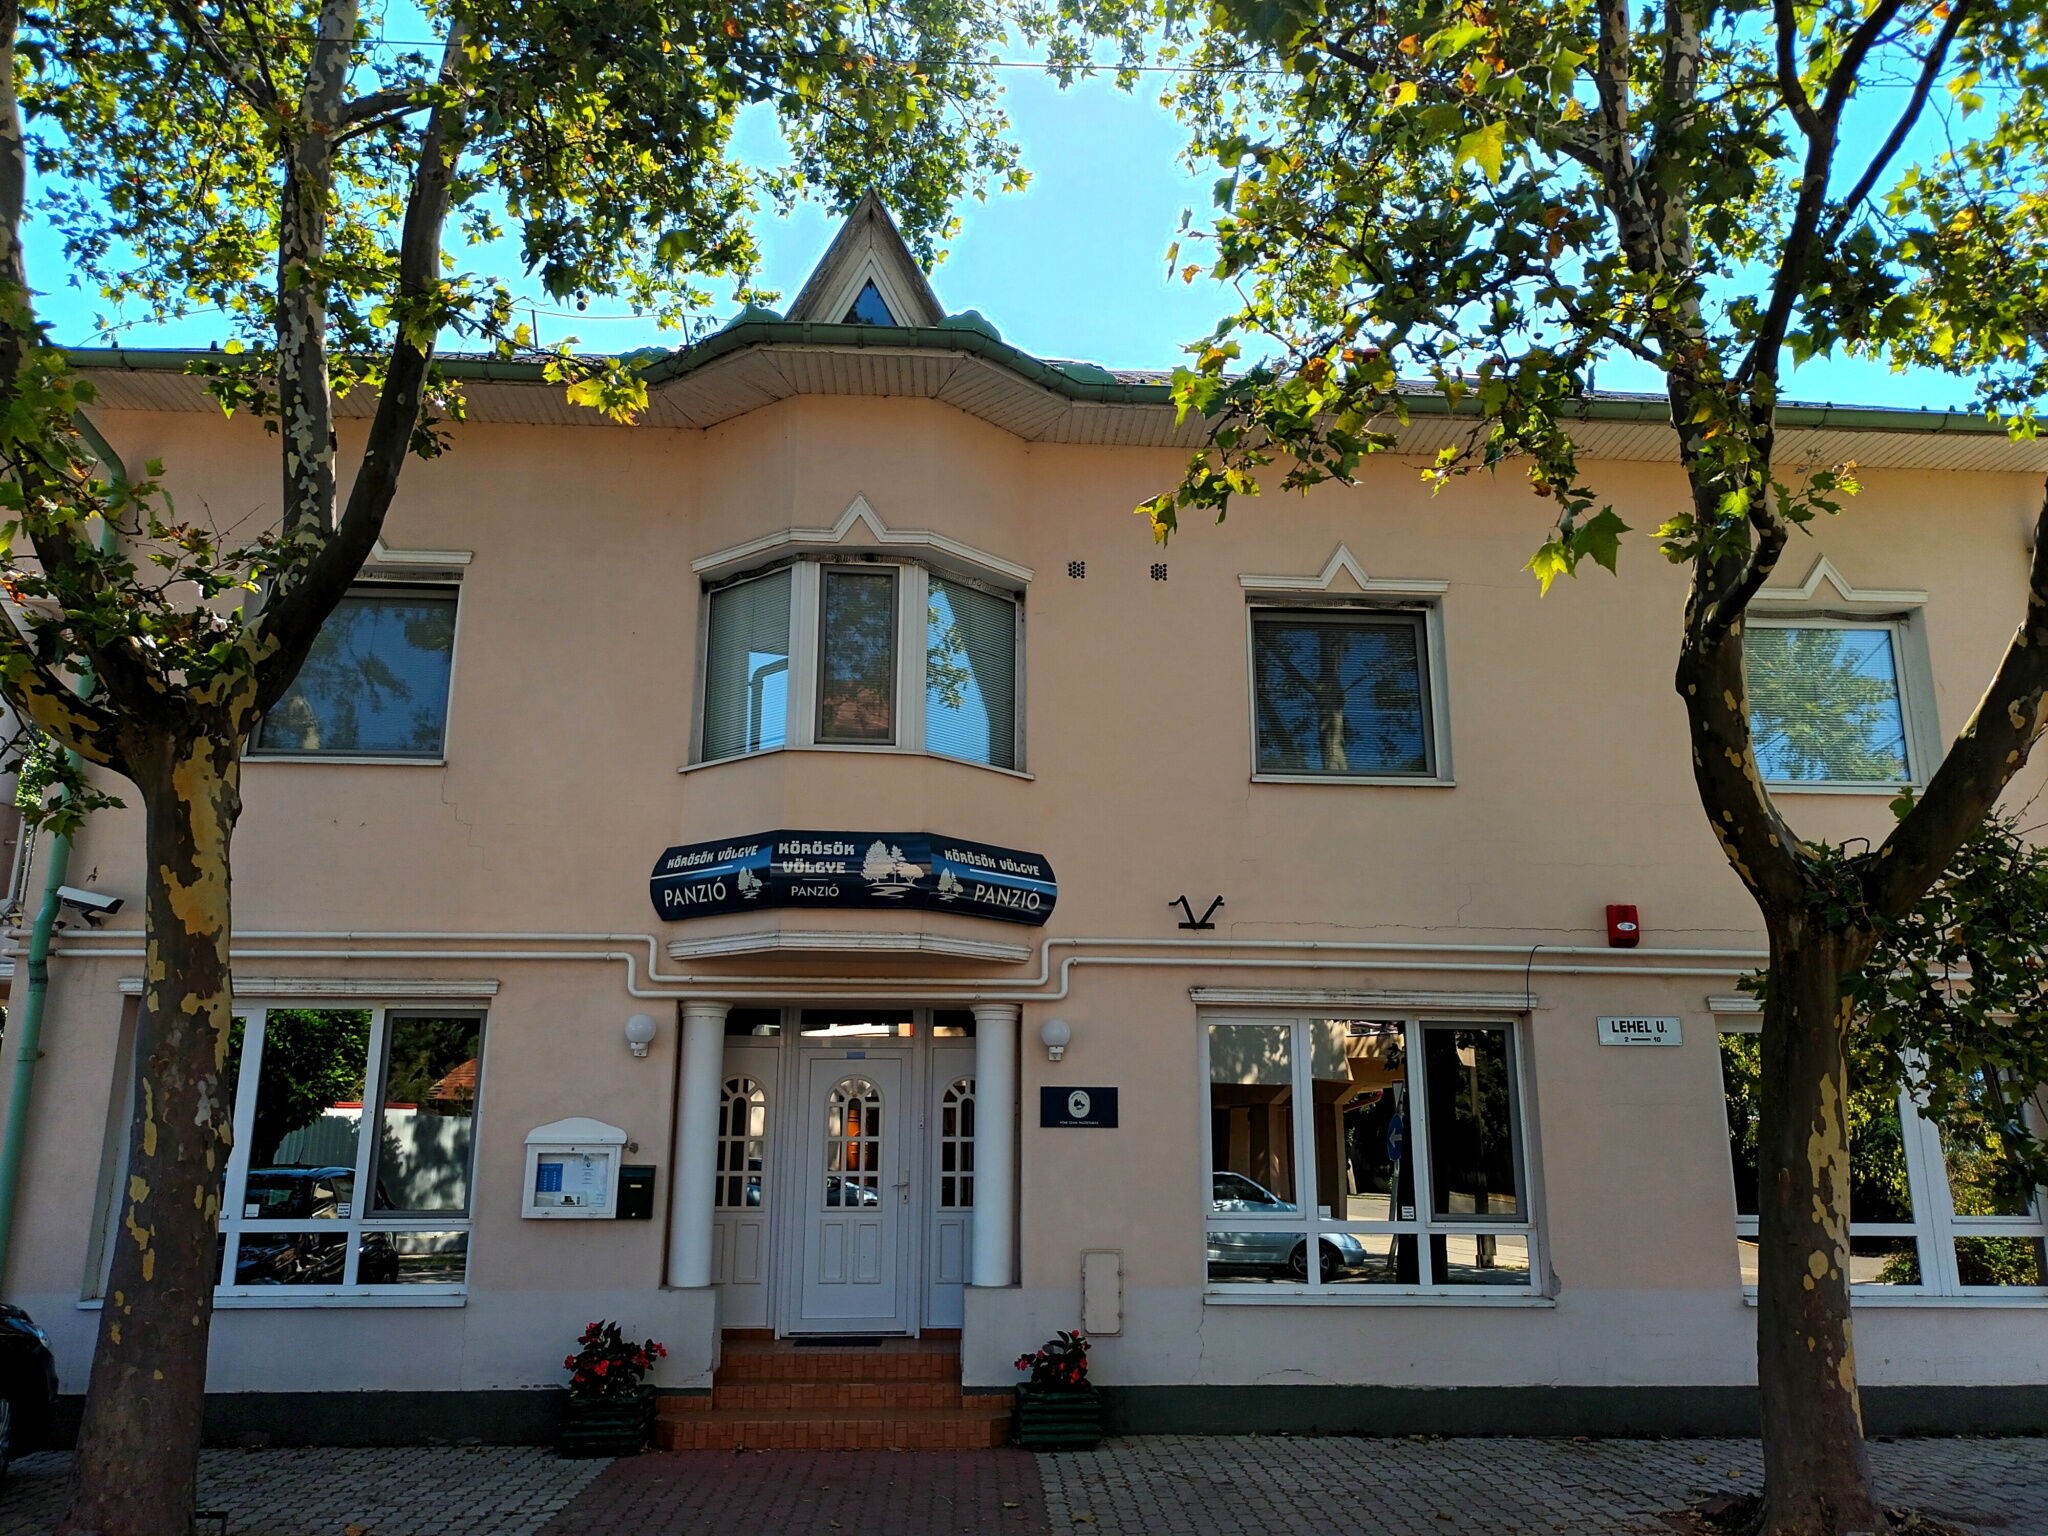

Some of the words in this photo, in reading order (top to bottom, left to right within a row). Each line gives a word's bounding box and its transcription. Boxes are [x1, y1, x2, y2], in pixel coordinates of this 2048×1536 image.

[666, 851, 715, 869] KÖRÖSÖK
[717, 845, 759, 861] VÖLGYE
[778, 840, 855, 855] KÖRÖSÖK
[782, 858, 846, 874] VÖLGYE
[944, 848, 996, 868] KÖRÖSÖK
[999, 858, 1040, 876] VÖLGYE
[664, 876, 726, 907] PANZIÓ
[791, 883, 840, 897] PANZIÓ
[974, 883, 1040, 910] PANZIÓ
[1611, 1020, 1652, 1033] LEHEL
[1656, 1020, 1668, 1033] U.
